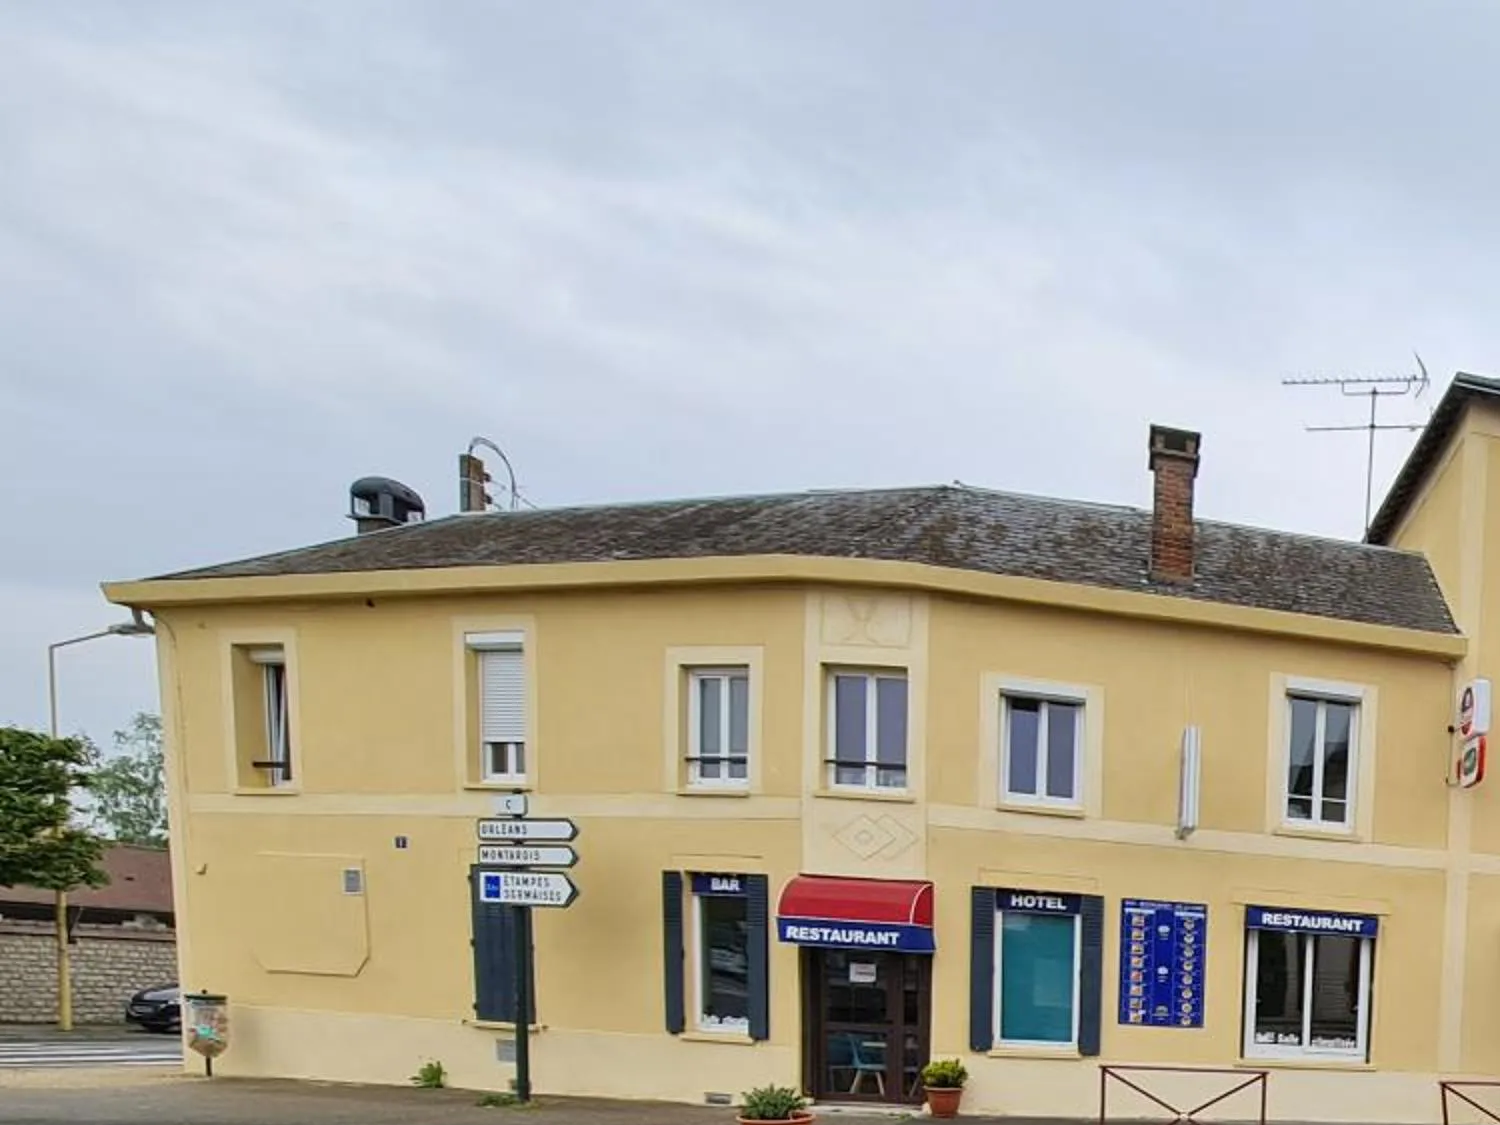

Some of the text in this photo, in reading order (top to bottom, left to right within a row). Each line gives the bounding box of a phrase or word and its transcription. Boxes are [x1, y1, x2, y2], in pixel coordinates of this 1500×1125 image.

[711, 878, 740, 892] BAR
[1011, 894, 1067, 910] HOTEL
[1261, 912, 1364, 932] RESTAURANT
[785, 925, 900, 945] RESTAURANT
